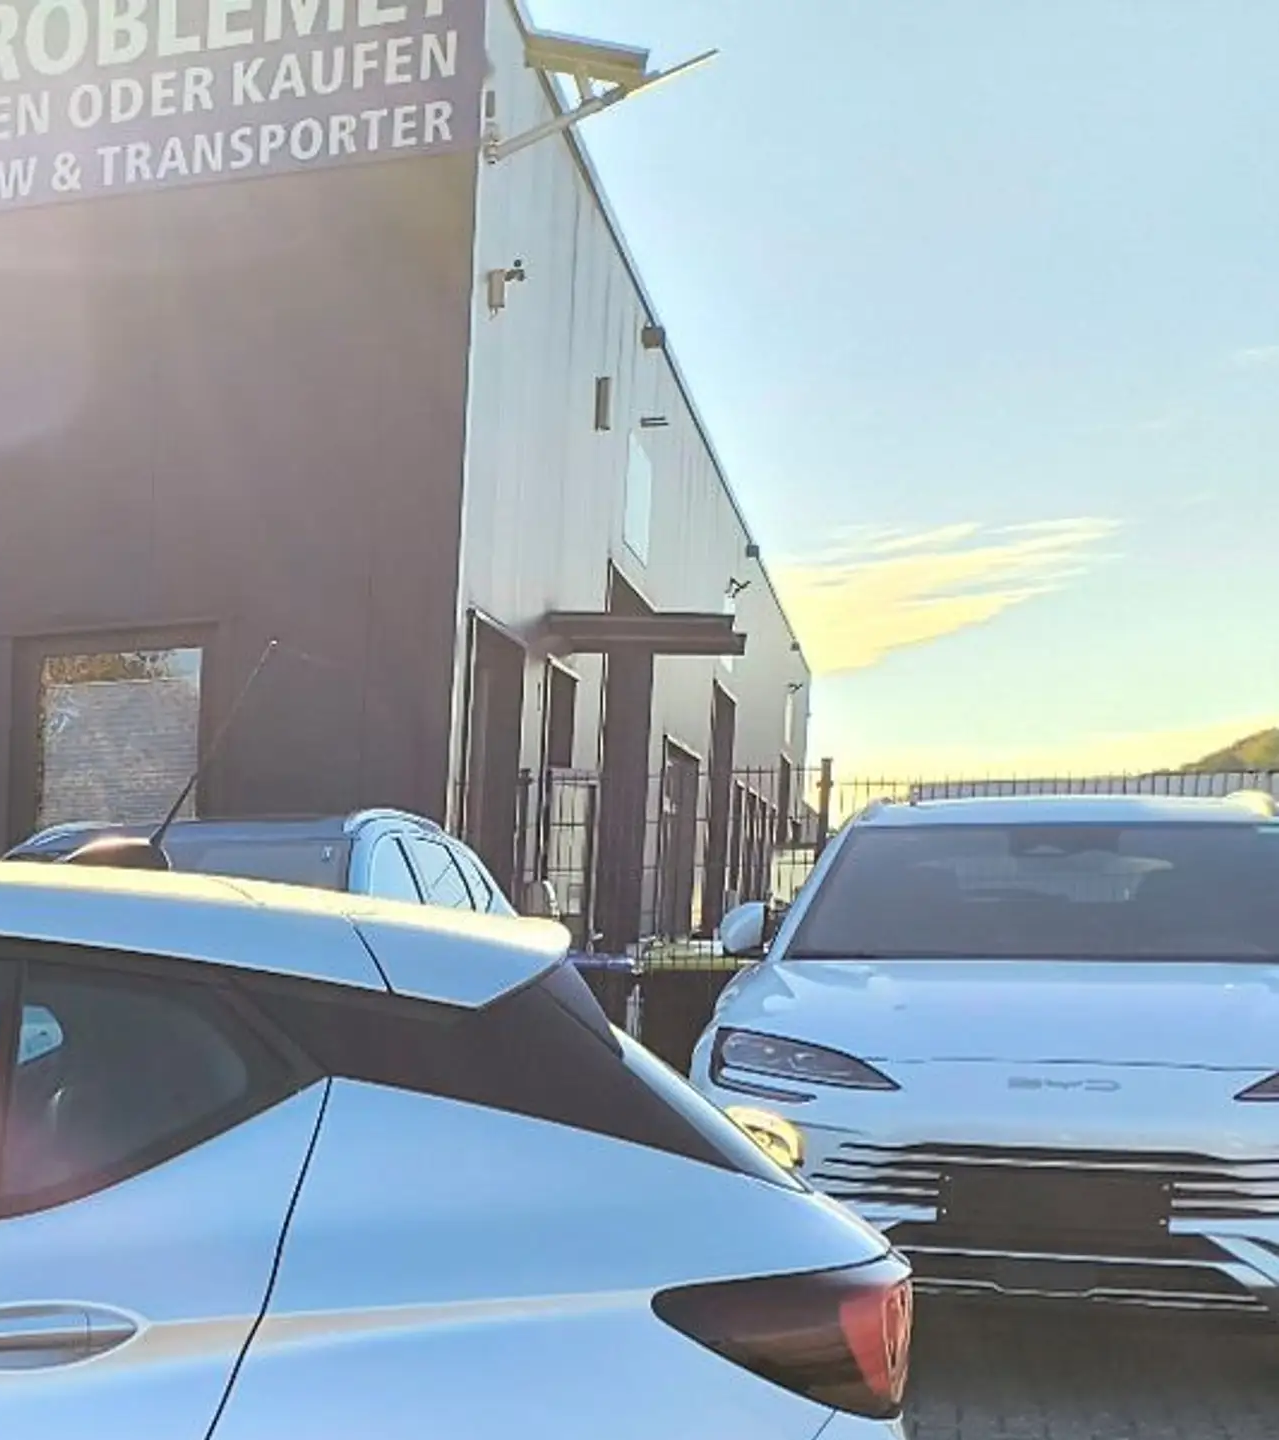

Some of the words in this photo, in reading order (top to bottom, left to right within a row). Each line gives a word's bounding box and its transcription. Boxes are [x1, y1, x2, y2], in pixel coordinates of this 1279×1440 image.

[67, 66, 214, 129] ODER
[231, 30, 458, 107] KAUFEN
[50, 151, 82, 193] &
[97, 100, 453, 187] TRANSPORTER
